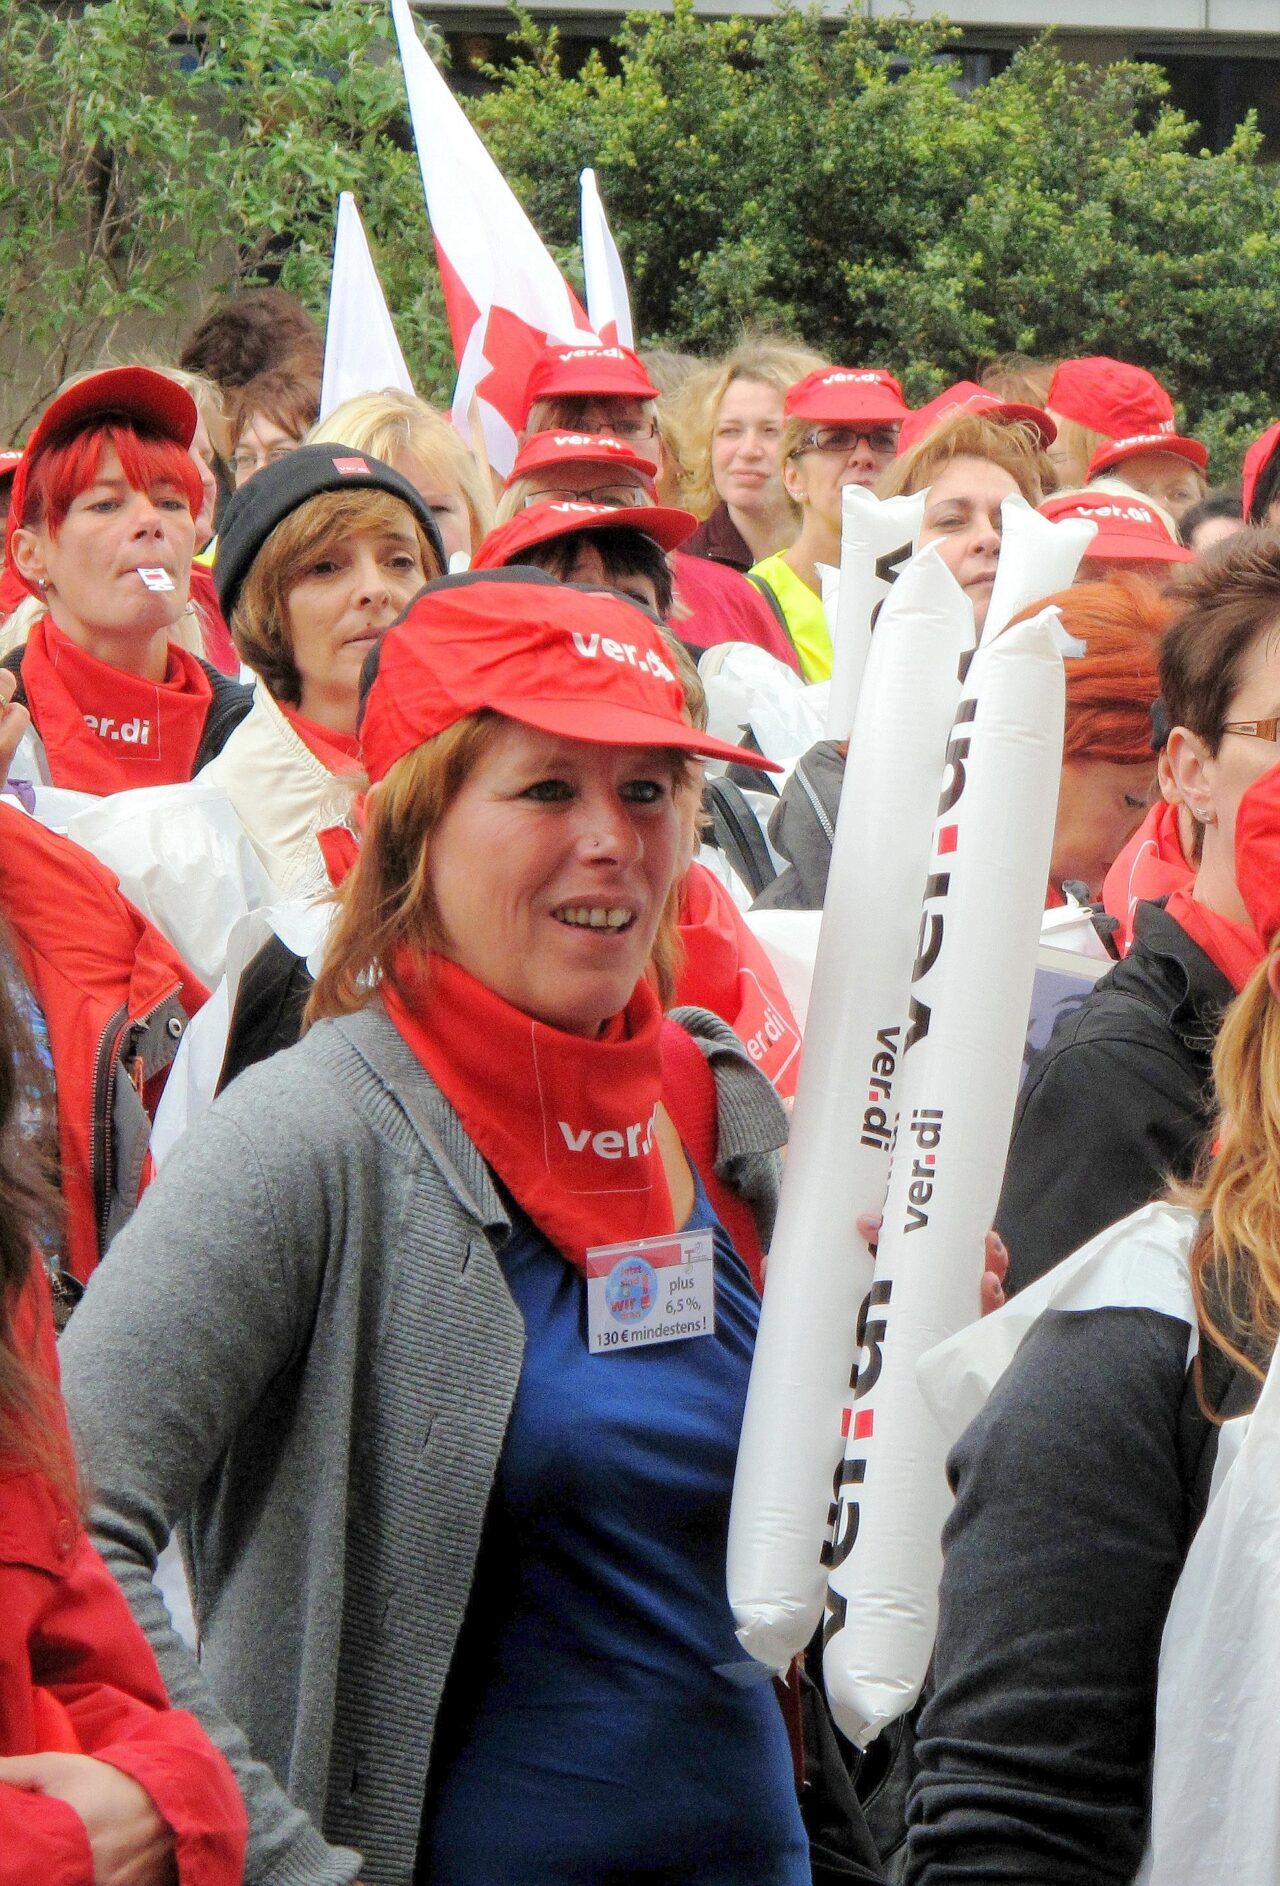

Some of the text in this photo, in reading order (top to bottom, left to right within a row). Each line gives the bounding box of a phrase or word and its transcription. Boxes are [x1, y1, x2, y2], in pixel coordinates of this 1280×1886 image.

[82, 714, 150, 745] er.di
[746, 1007, 785, 1060] er.di
[861, 1026, 901, 1150] ver.di
[904, 1109, 944, 1234] ver.di
[668, 1277, 695, 1294] plus
[665, 1300, 684, 1315] 6,5
[596, 1331, 619, 1347] 130
[621, 1329, 629, 1343] €
